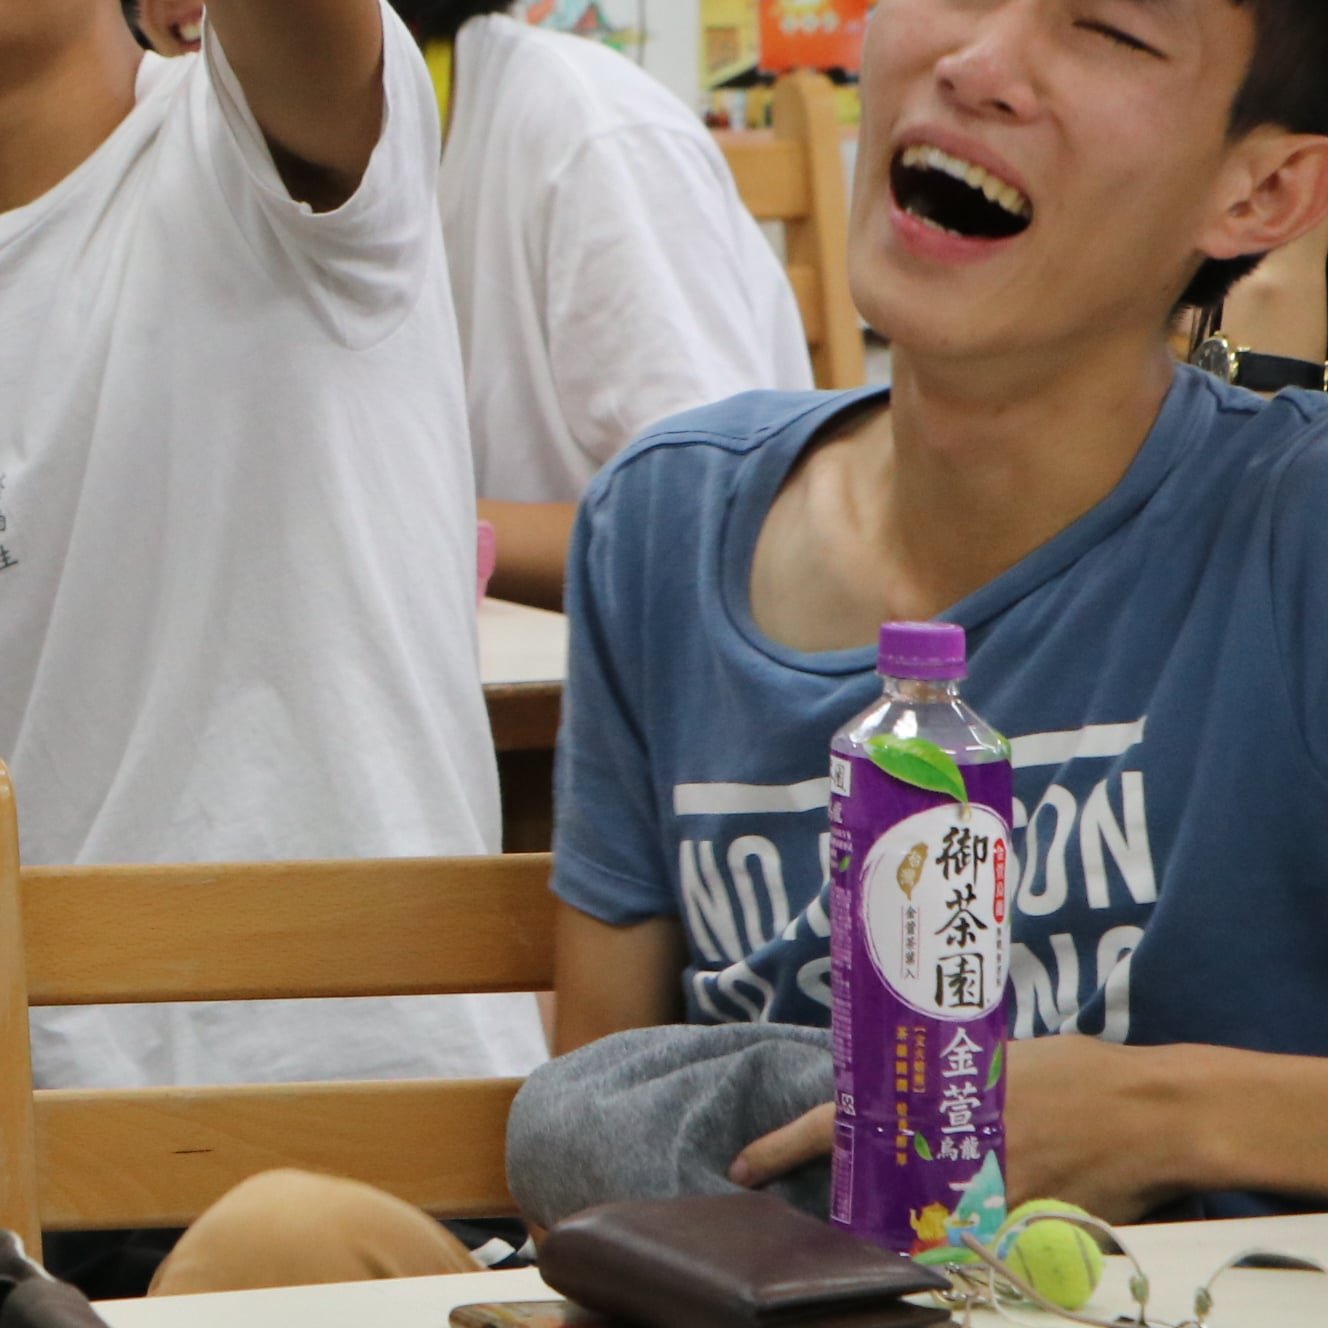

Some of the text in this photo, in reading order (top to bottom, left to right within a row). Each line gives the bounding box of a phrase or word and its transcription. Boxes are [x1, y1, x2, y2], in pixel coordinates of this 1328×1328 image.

[934, 826, 989, 1010] 御茶園
[938, 1026, 985, 1134] 金萱
[936, 1135, 982, 1162] 烏龍
